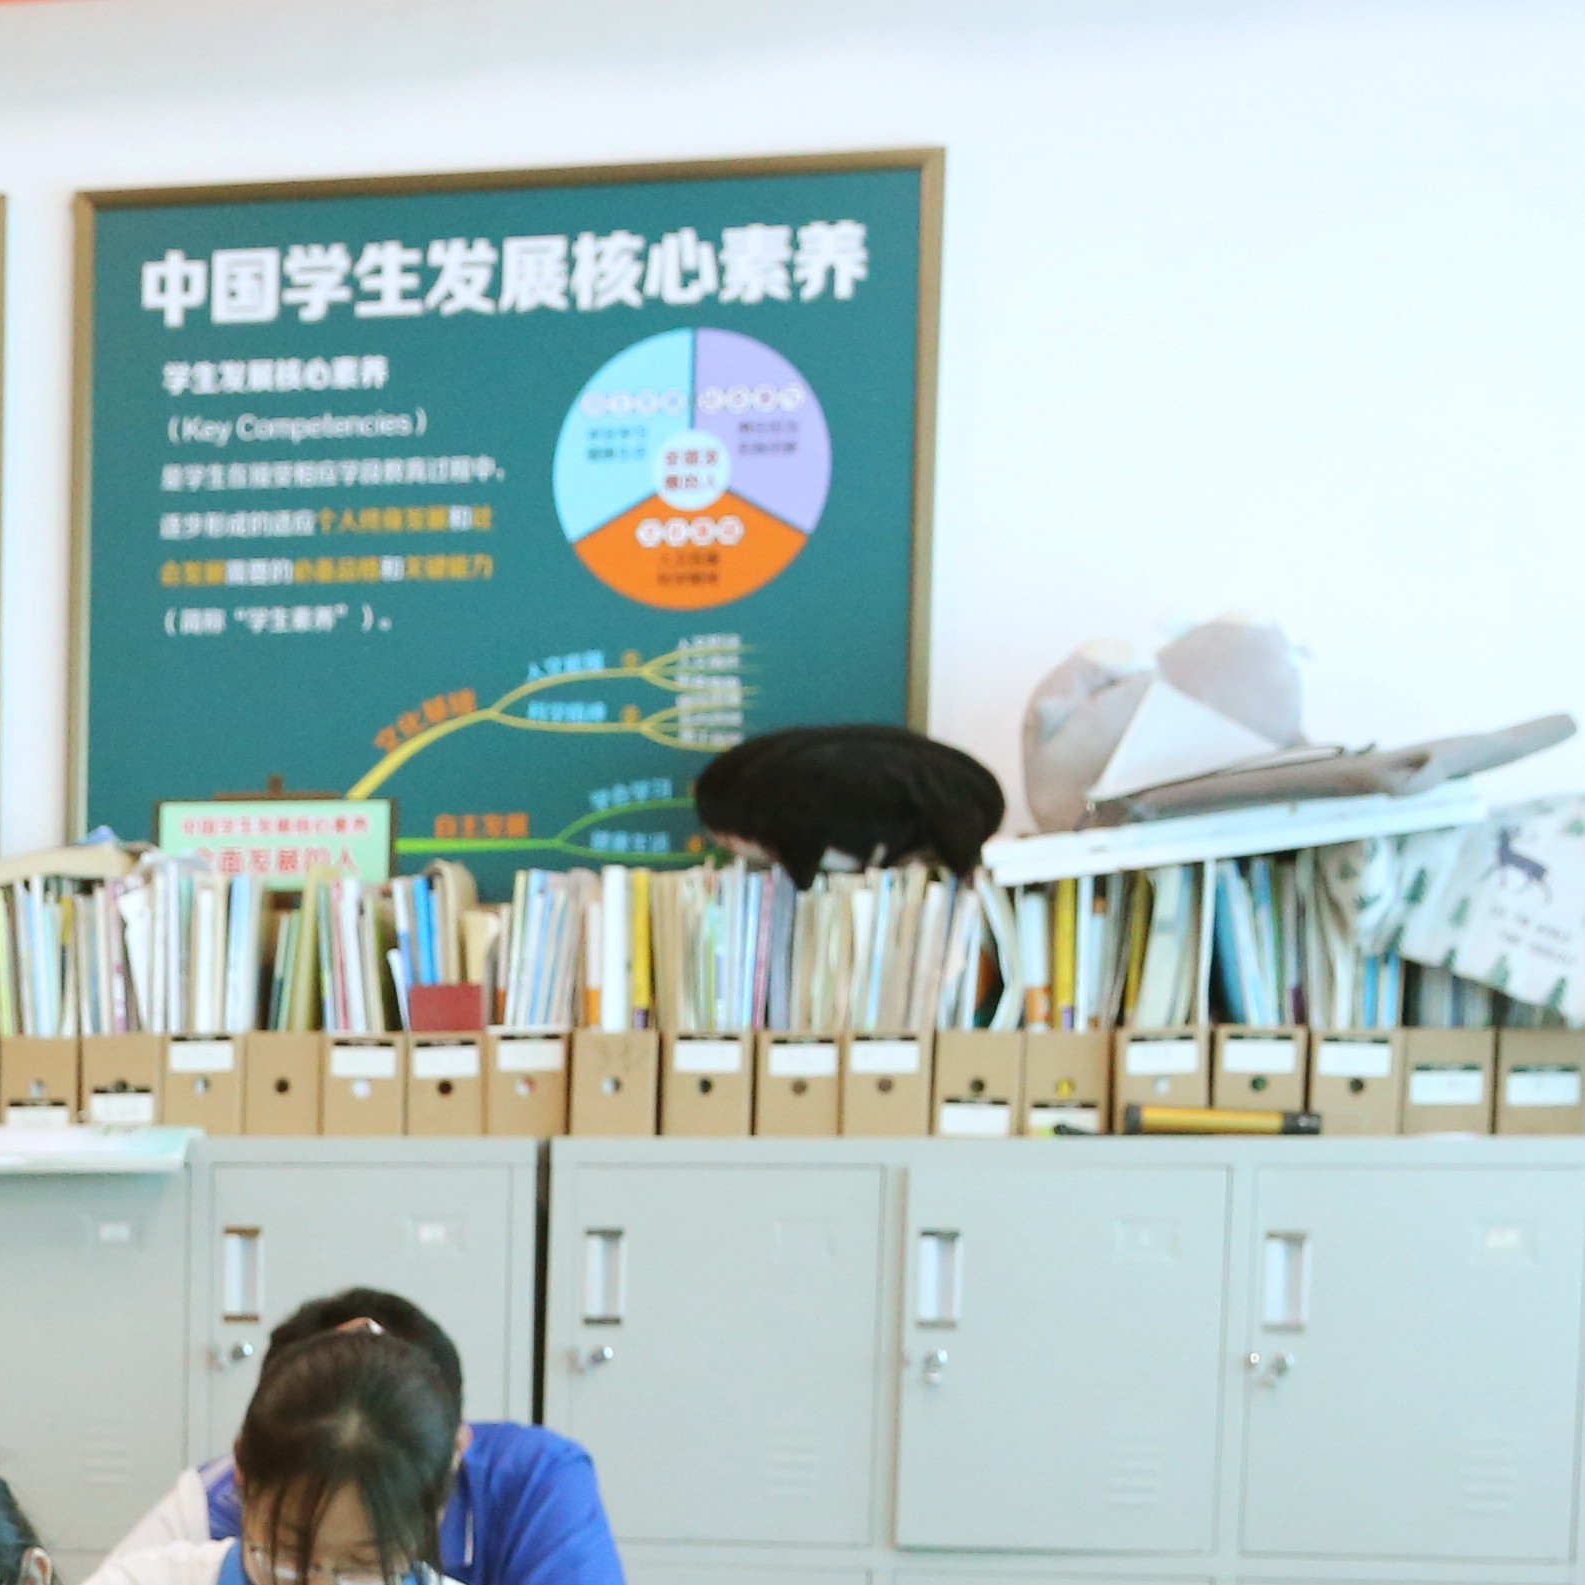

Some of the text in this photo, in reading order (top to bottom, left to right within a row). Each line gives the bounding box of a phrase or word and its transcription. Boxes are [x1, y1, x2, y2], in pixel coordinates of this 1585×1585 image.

[141, 220, 870, 328] 中国学生发展核心素养
[162, 354, 389, 396] 学生发展核心素养
